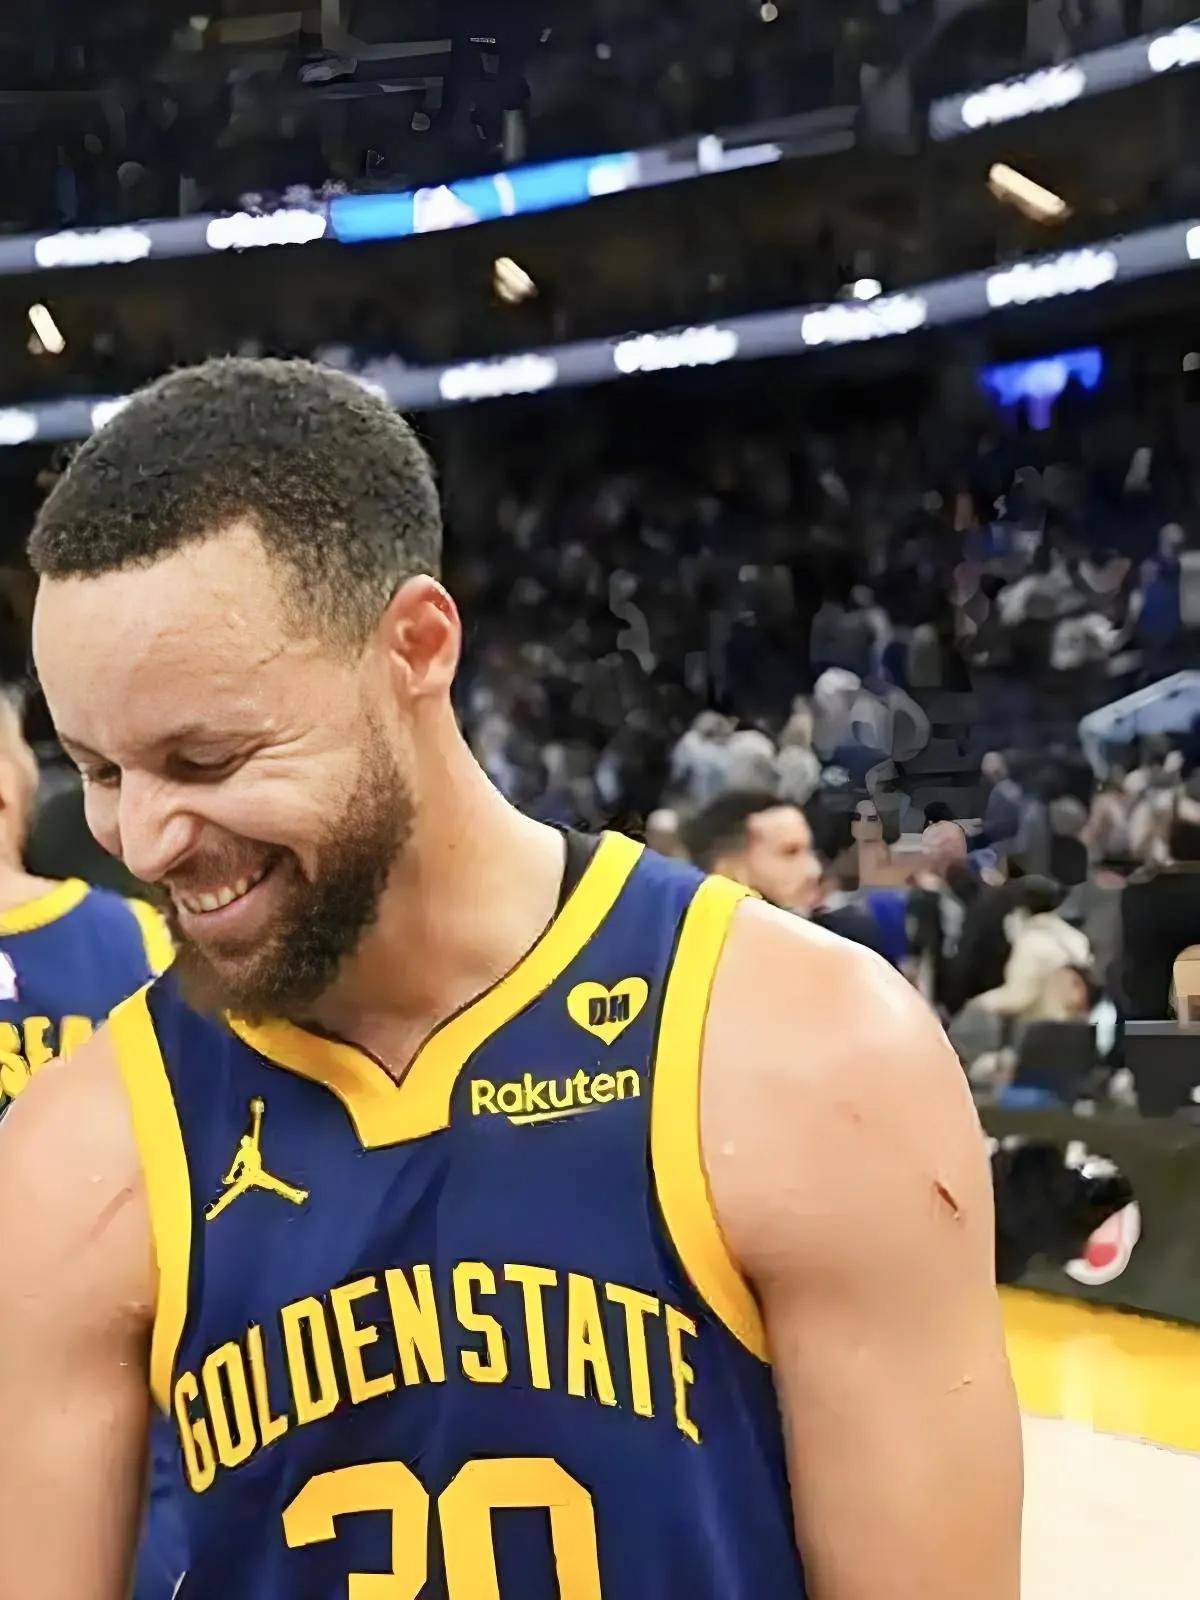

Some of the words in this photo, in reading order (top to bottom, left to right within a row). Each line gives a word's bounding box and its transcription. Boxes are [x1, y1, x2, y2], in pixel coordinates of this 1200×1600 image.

[470, 1068, 641, 1116] Rakuten
[174, 1264, 447, 1493] GOLDEN
[452, 1261, 702, 1445] STATE
